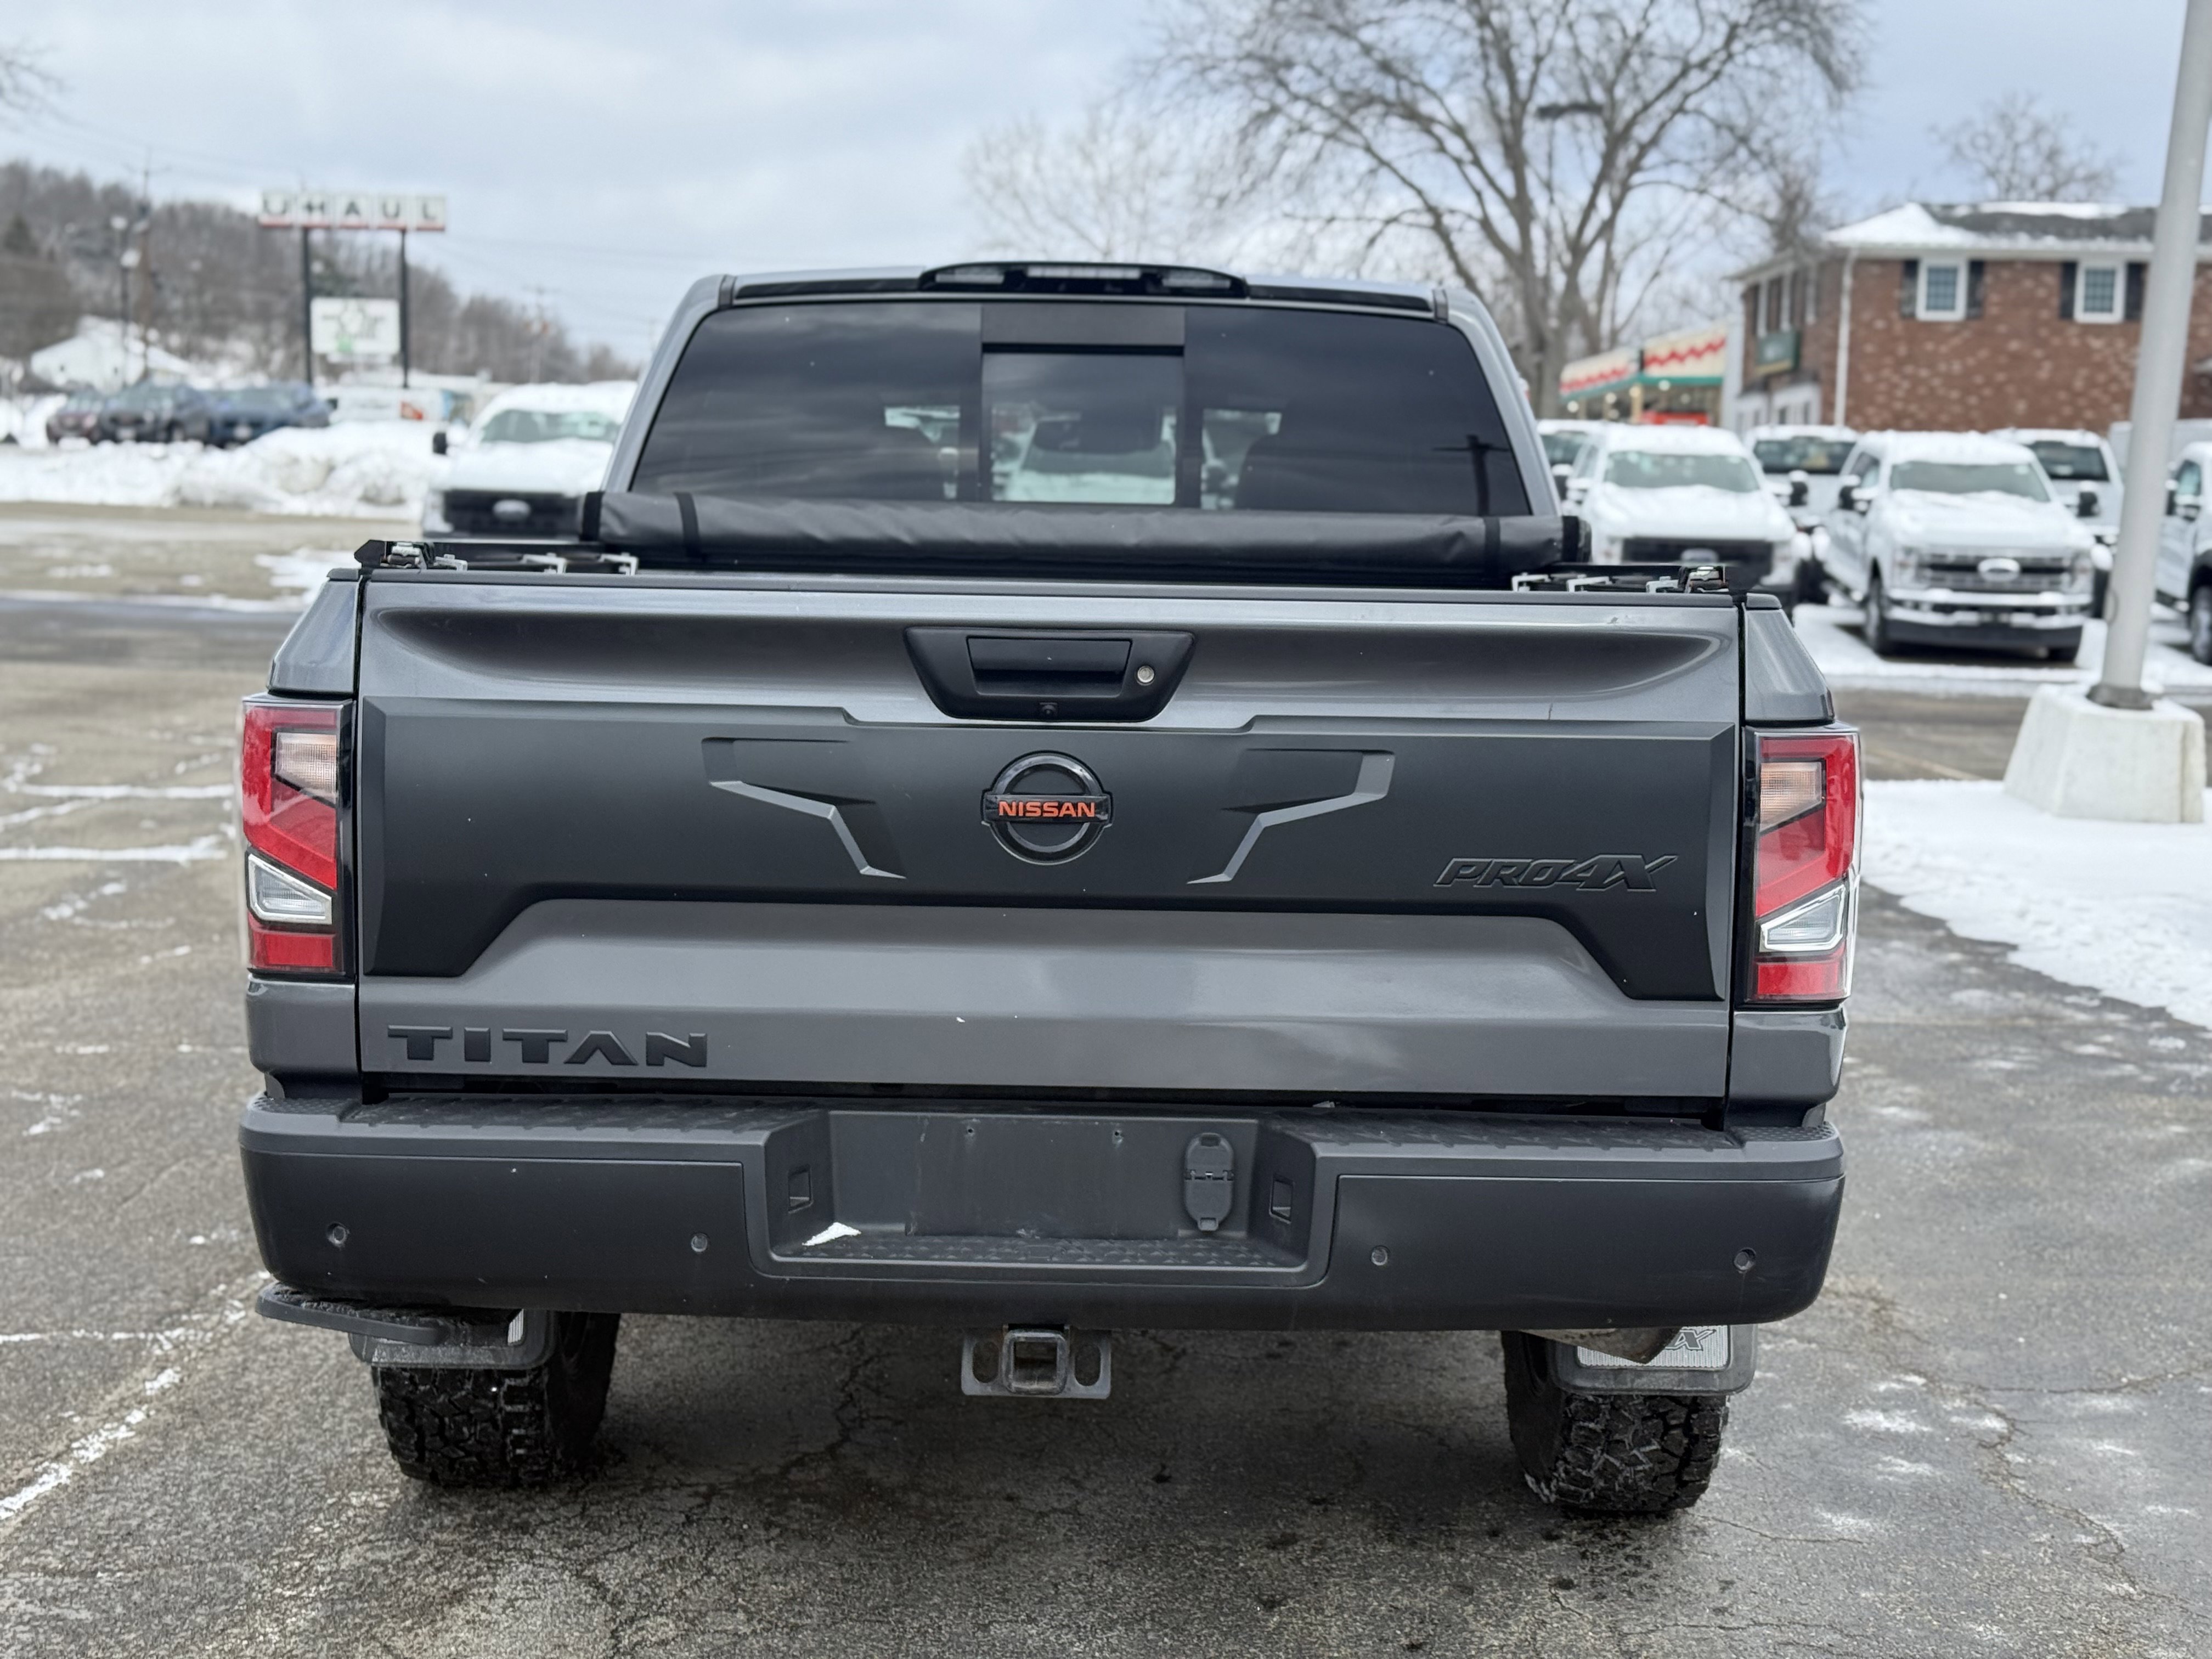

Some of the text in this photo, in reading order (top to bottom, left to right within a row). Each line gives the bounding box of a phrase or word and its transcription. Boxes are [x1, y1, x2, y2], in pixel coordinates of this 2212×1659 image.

[997, 800, 1096, 817] NISSAN
[1432, 853, 1679, 892] PRO4X
[387, 1024, 707, 1068] TITAN
